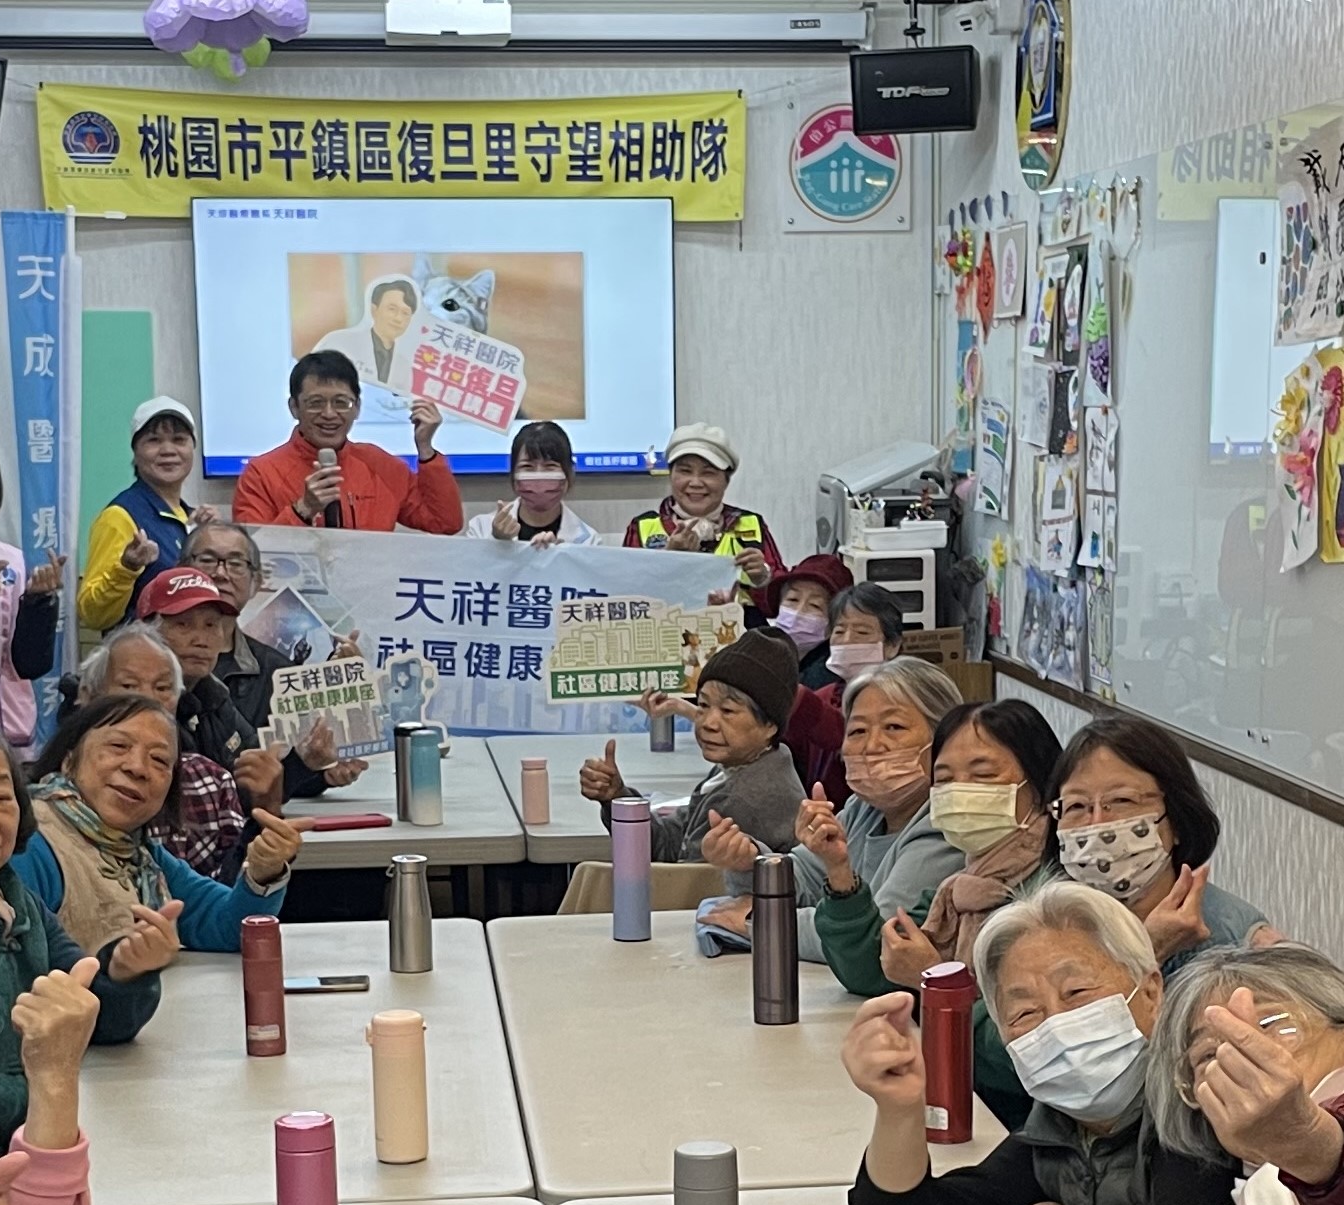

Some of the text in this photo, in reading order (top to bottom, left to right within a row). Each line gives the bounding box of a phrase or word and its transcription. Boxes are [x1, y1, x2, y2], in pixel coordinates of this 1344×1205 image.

[138, 112, 729, 184] 桃園市平鎮區復旦里守望相助隊
[432, 322, 520, 375] 天祥醫院
[413, 343, 520, 400] 幸福復旦
[561, 600, 652, 624] 天祥醫院
[279, 662, 366, 694] 天祥醫院
[557, 671, 681, 695] 社區健康講座
[276, 683, 376, 715] 社區健康講座
